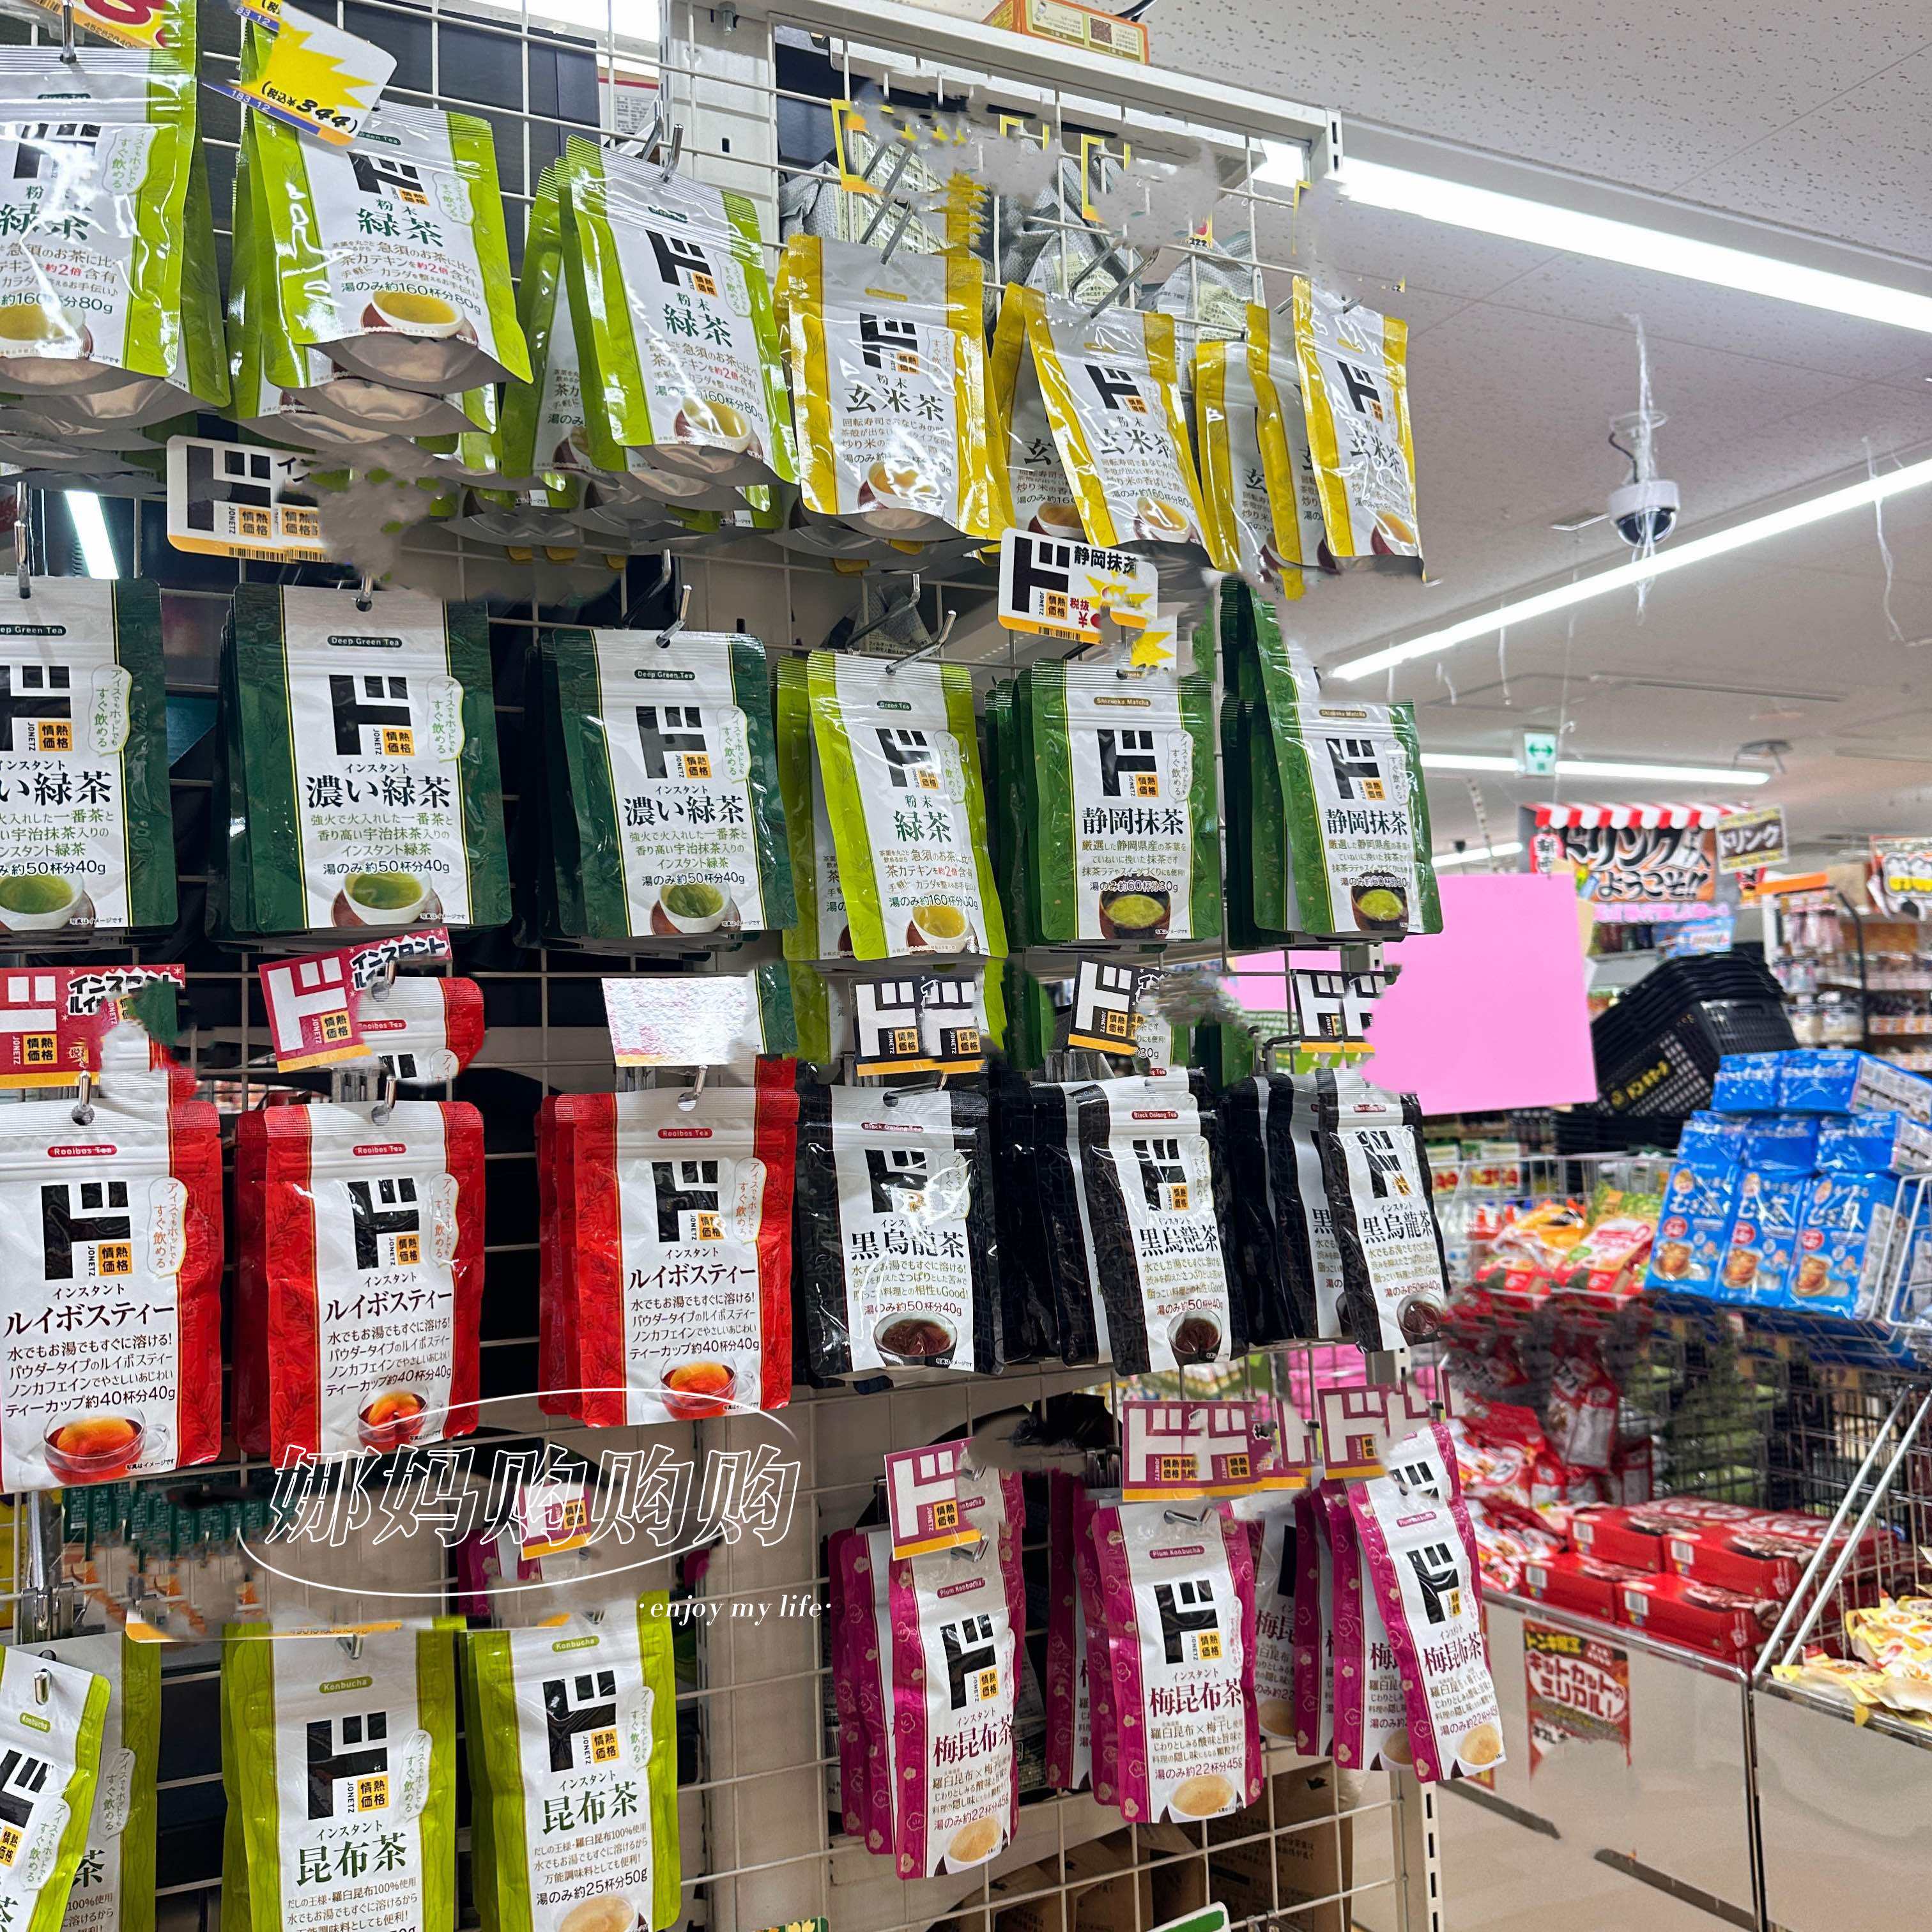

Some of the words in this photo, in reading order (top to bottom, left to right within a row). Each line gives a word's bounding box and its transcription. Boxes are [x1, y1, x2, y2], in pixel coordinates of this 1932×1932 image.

[356, 208, 443, 247] 緑茶
[677, 291, 709, 311] 粉末
[663, 303, 733, 348] 緑茶
[843, 383, 945, 422] 玄米茶
[332, 637, 353, 645] Deep
[638, 671, 656, 680] Deep
[95, 688, 108, 747] すぐ飲める
[432, 700, 445, 754] すぐ飲める
[372, 728, 382, 755] JONETZ
[386, 731, 411, 742] 情熱
[387, 742, 412, 753] 価格
[722, 727, 736, 776] すぐ飲める
[346, 763, 410, 774] インスタント
[675, 755, 684, 778] JONETZ
[1170, 749, 1181, 795] すぐ飲める
[306, 774, 451, 808] 濃い緑茶
[656, 785, 708, 794] インスタント
[624, 795, 744, 827] 濃い緑茶
[905, 794, 933, 809] 粉末
[311, 813, 453, 827] 強火で火入れした一番茶と
[894, 811, 953, 843] 緑茶
[1082, 808, 1184, 835] 静岡抹茶
[1326, 809, 1407, 836] 静岡抹茶
[318, 827, 450, 841] 香り高い宇治抹茶入りの
[629, 828, 747, 842] 強火で火入れした一番茶と
[341, 843, 432, 857] インスタント緑茶
[636, 843, 744, 856] 香り高い宇治抹茶入りの
[1082, 841, 1186, 851] 厳選した静岡県産の茶葉を
[323, 860, 450, 875] 湯のみ約50杯分40g
[657, 857, 729, 870] インスタント緑茶
[1092, 855, 1178, 864] ていねいに挽いた抹茶です
[641, 872, 745, 886] 湯のみ約50杯分40g
[1089, 880, 1178, 893] 湯のみ約60杯分30g
[311, 1018, 322, 1045] JONETZ
[27, 1038, 53, 1048] 情熱
[27, 1050, 53, 1061] 価格
[54, 1147, 92, 1156] Rooibos
[153, 1206, 167, 1268] すぐ飲める
[1363, 1211, 1432, 1244] 黒烏龍茶
[1140, 1225, 1218, 1257] 黒烏龍茶
[102, 1247, 128, 1259] 情熱
[665, 1247, 719, 1259] インスタント
[102, 1261, 128, 1273] 価格
[628, 1263, 756, 1291] ルイボスティー
[364, 1272, 417, 1288] インスタント
[53, 1284, 125, 1300] インスタント
[631, 1292, 755, 1311] 水でもお湯でもすぐに溶ける!
[324, 1289, 452, 1324] ルイボスティー
[3, 1303, 174, 1338] ルイボスティー
[632, 1309, 756, 1328] パウダータイプのルイボスティー
[327, 1317, 450, 1345] 水でもお湯でもすぐに溶ける!
[632, 1324, 756, 1342] ノンカフェインでやさしいあじわい
[7, 1333, 172, 1361] 水でもお湯でもすぐに溶ける!
[329, 1336, 450, 1362] パウダータイプのルイボスティー
[629, 1338, 759, 1360] ティーカップ約40杯分40g
[10, 1354, 172, 1380] パウダータイプのルイボスティー
[328, 1351, 450, 1379] ノンカフェインでやさしいあじわい
[9, 1370, 173, 1398] ノンカフェインでやさしいあじわい
[326, 1365, 452, 1397] ティーカップ約40杯分40g
[5, 1386, 175, 1418] ティーカップ約40杯分40g
[1170, 1546, 1201, 1556] Konbucha
[556, 1639, 595, 1651] Konbucha
[1423, 1633, 1482, 1676] 梅昆布茶
[1172, 1667, 1218, 1681] インスタント
[324, 1679, 367, 1692] Konbucha
[1150, 1678, 1242, 1717] 梅昆布茶
[956, 1709, 995, 1726] インスタント
[583, 1736, 591, 1765] JONETZ
[933, 1717, 1012, 1767] 梅昆布茶
[1154, 1758, 1243, 1779] 湯のみ約22杯分45g
[360, 1779, 385, 1794] 情熱
[559, 1770, 617, 1791] インスタント
[103, 1774, 118, 1830] すぐ飲める
[361, 1793, 385, 1807] 価格
[542, 1781, 638, 1835] 昆布茶
[316, 1820, 383, 1841] インスタント
[296, 1832, 407, 1887] 昆布茶
[534, 1837, 648, 1871] 水でもお湯でもすぐに溶けるから
[544, 1854, 641, 1885] 万能調味料としても便利!
[536, 1867, 648, 1905] 湯のみ約25杯分50g
[288, 1892, 417, 1925] 水でもお湯でもすぐに溶けるから
